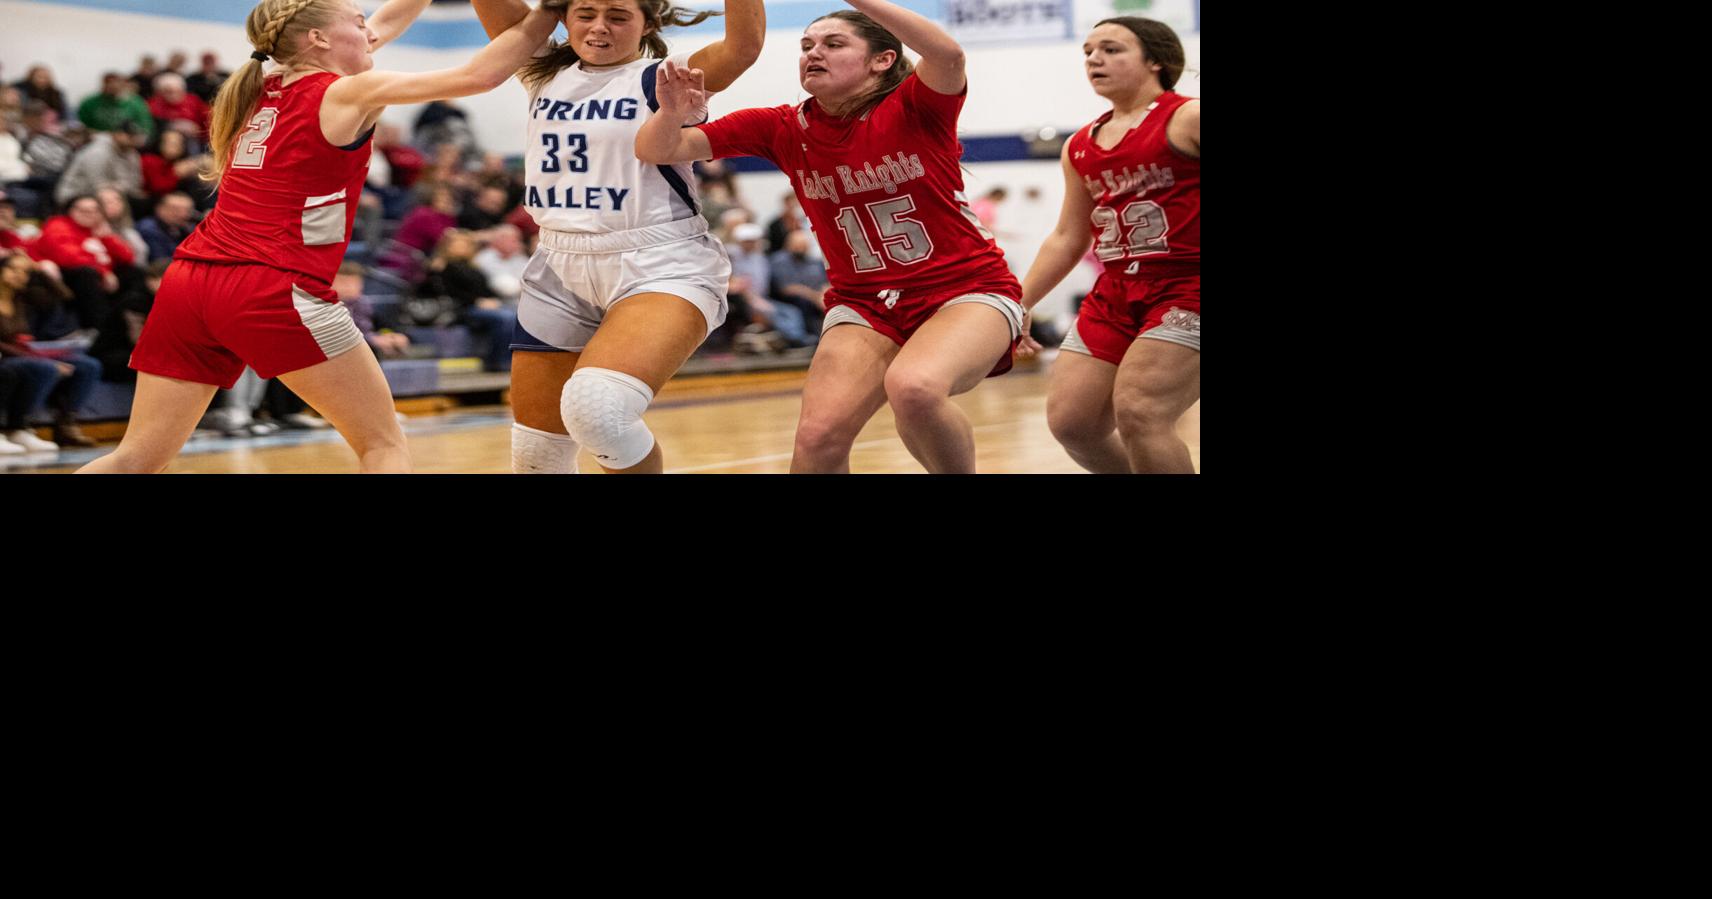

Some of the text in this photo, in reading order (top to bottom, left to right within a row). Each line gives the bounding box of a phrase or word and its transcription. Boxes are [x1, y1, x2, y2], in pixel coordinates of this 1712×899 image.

[533, 97, 638, 120] PRING
[232, 107, 279, 169] 2
[541, 133, 588, 173] 33
[836, 151, 925, 195] Knights
[524, 185, 630, 211] ALLEY
[835, 194, 933, 273] 15
[1090, 200, 1170, 262] 22
